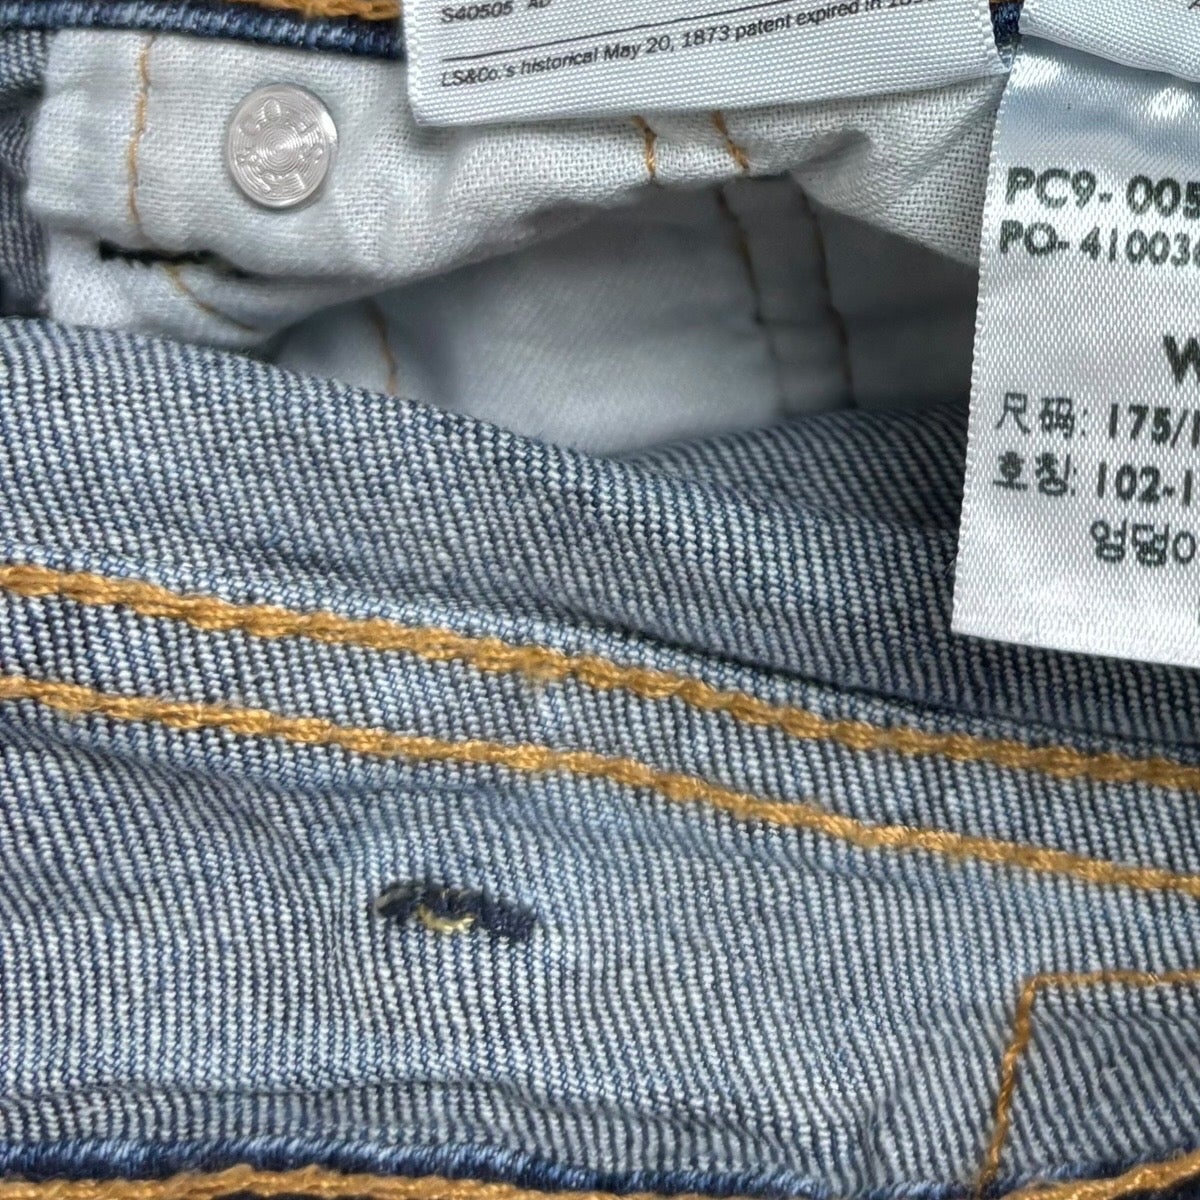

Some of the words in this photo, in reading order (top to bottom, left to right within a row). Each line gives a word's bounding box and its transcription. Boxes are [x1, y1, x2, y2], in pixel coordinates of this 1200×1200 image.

[440, 0, 515, 24] S40505
[520, 48, 599, 76] historical
[604, 43, 642, 62] May
[645, 35, 675, 54] 20,
[682, 25, 731, 50] 1873
[734, 14, 792, 41] patent
